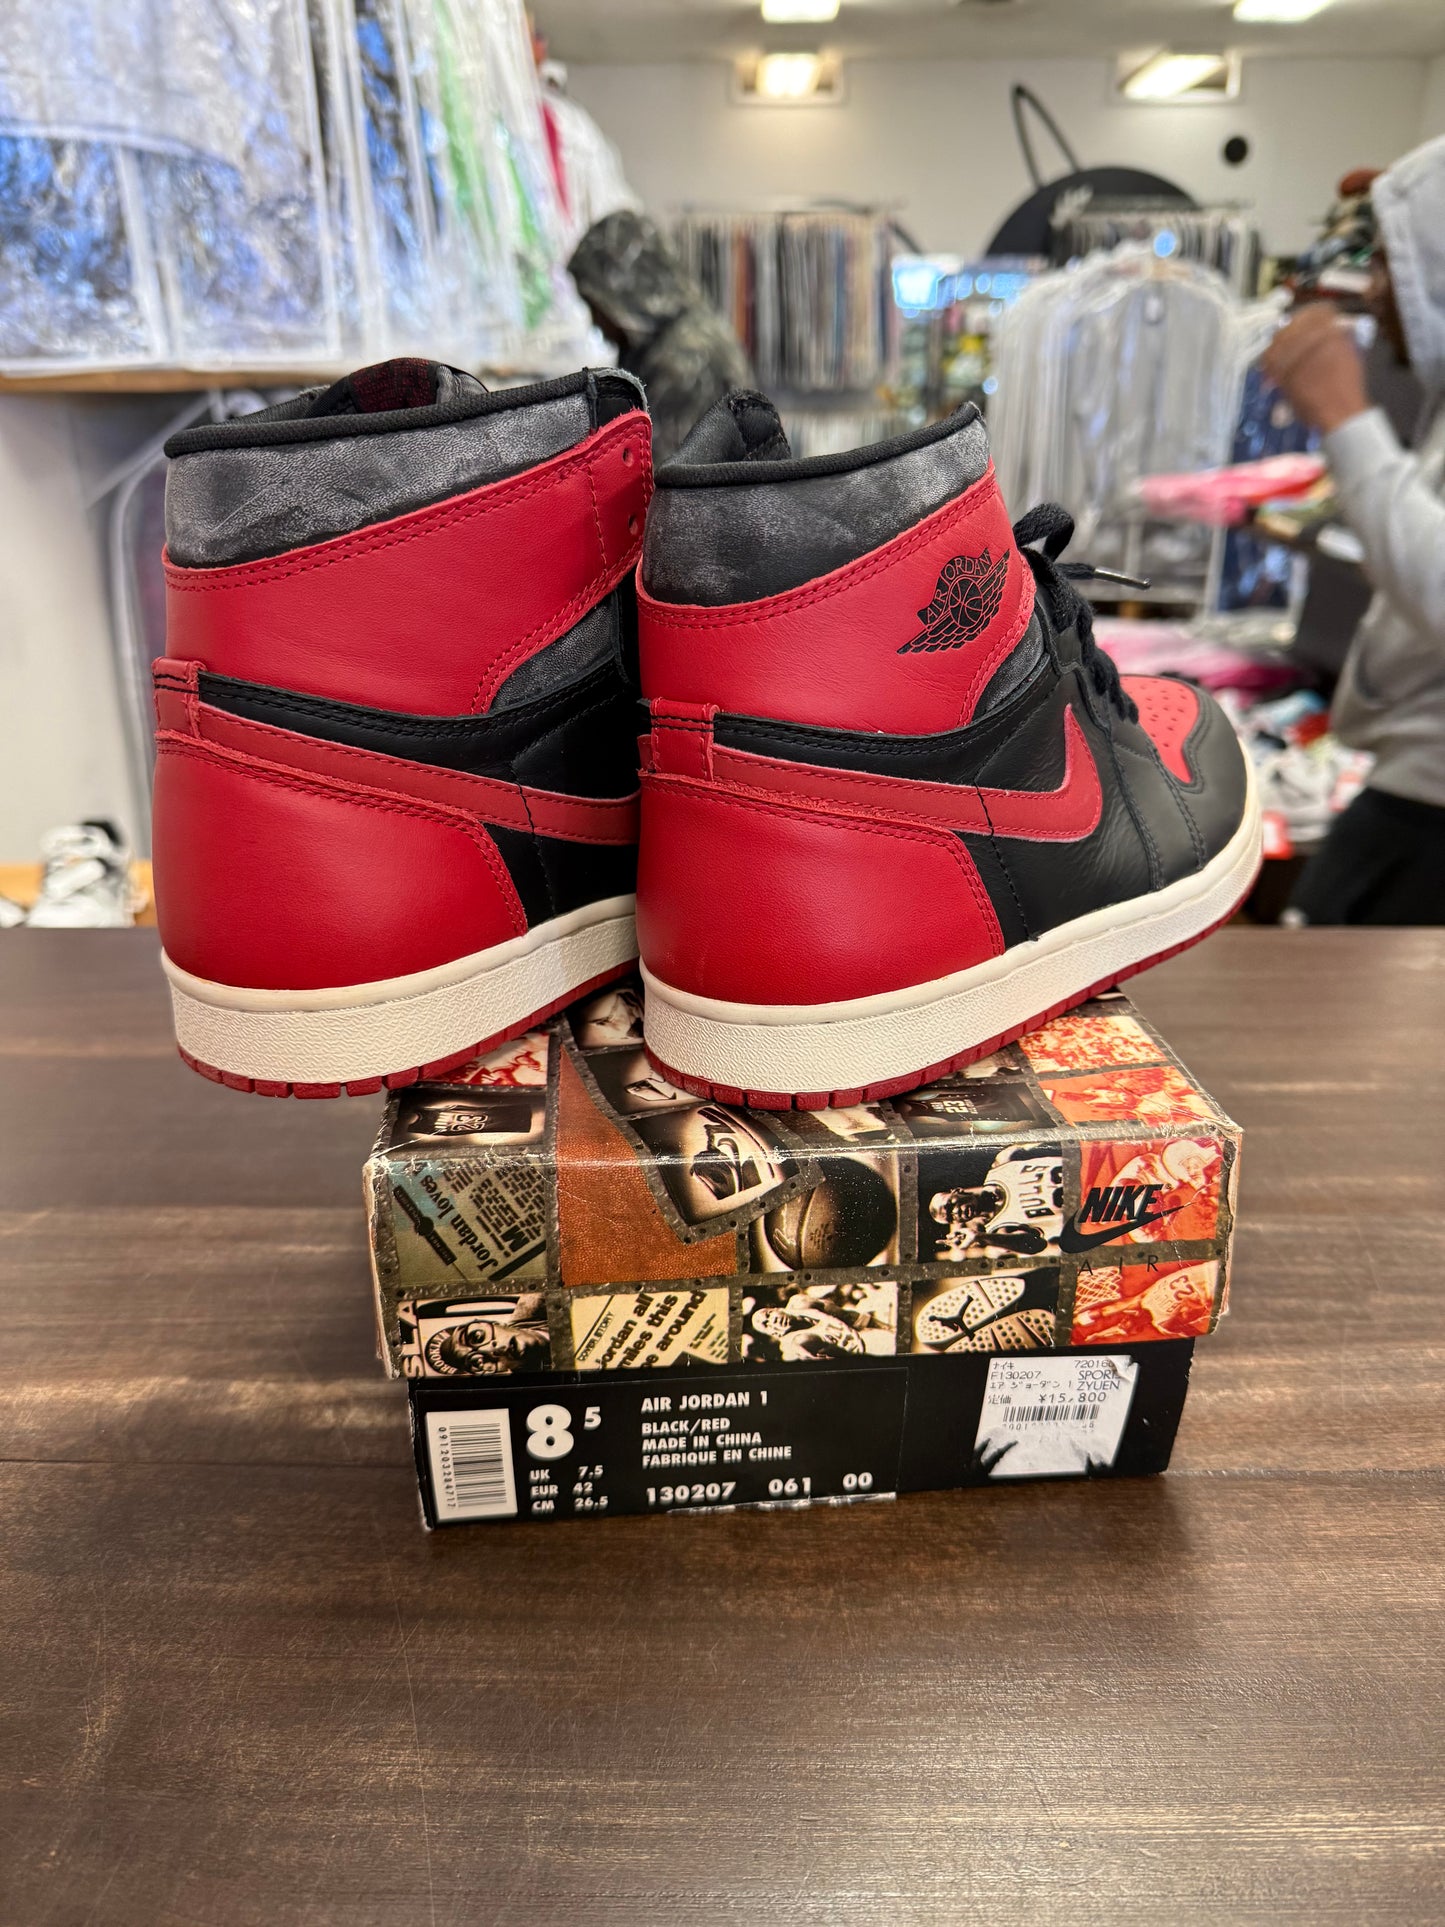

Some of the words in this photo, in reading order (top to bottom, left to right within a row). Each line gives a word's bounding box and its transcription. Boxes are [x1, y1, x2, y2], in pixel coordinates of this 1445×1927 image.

[925, 588, 949, 624] AIR
[940, 552, 993, 586] JORDAN
[942, 1100, 969, 1114] 23
[451, 1113, 489, 1132] 23
[420, 1174, 456, 1220] loves
[1018, 1165, 1055, 1219] BULLS
[1078, 1184, 1164, 1223] NIKE
[451, 1214, 498, 1272] Jordan
[1077, 1254, 1159, 1276] AIR
[1169, 1275, 1195, 1301] 23
[633, 1293, 655, 1318] all
[646, 1294, 679, 1328] this
[656, 1290, 708, 1352] around
[577, 1335, 600, 1362] COVER
[595, 1311, 615, 1341] STORY
[429, 1328, 458, 1375] BROOKLYN
[991, 1370, 1042, 1380] F130207
[992, 1361, 1015, 1370] ナイキ
[1038, 1391, 1107, 1404] ¥15,800
[1076, 1380, 1120, 1391] ZYUEN
[641, 1396, 672, 1413] AIR
[679, 1391, 750, 1410] JORDAN
[760, 1390, 768, 1406] 1
[526, 1404, 575, 1461] 8
[583, 1406, 602, 1431] 5
[641, 1417, 731, 1436] BLACK/RED
[642, 1437, 687, 1452] MADE
[693, 1435, 709, 1448] IN
[716, 1431, 762, 1447] CHINA
[642, 1451, 717, 1469] FABRIQUE
[723, 1449, 742, 1463] EN
[749, 1445, 792, 1461] CHINE
[529, 1469, 551, 1482] UK
[578, 1464, 603, 1480] 7.5
[530, 1484, 559, 1498] EUR
[572, 1481, 594, 1495] 42
[646, 1481, 737, 1506] 130207
[768, 1476, 812, 1497] 061
[842, 1471, 873, 1491] 00
[532, 1500, 555, 1514] CM
[574, 1495, 609, 1510] 26.5
